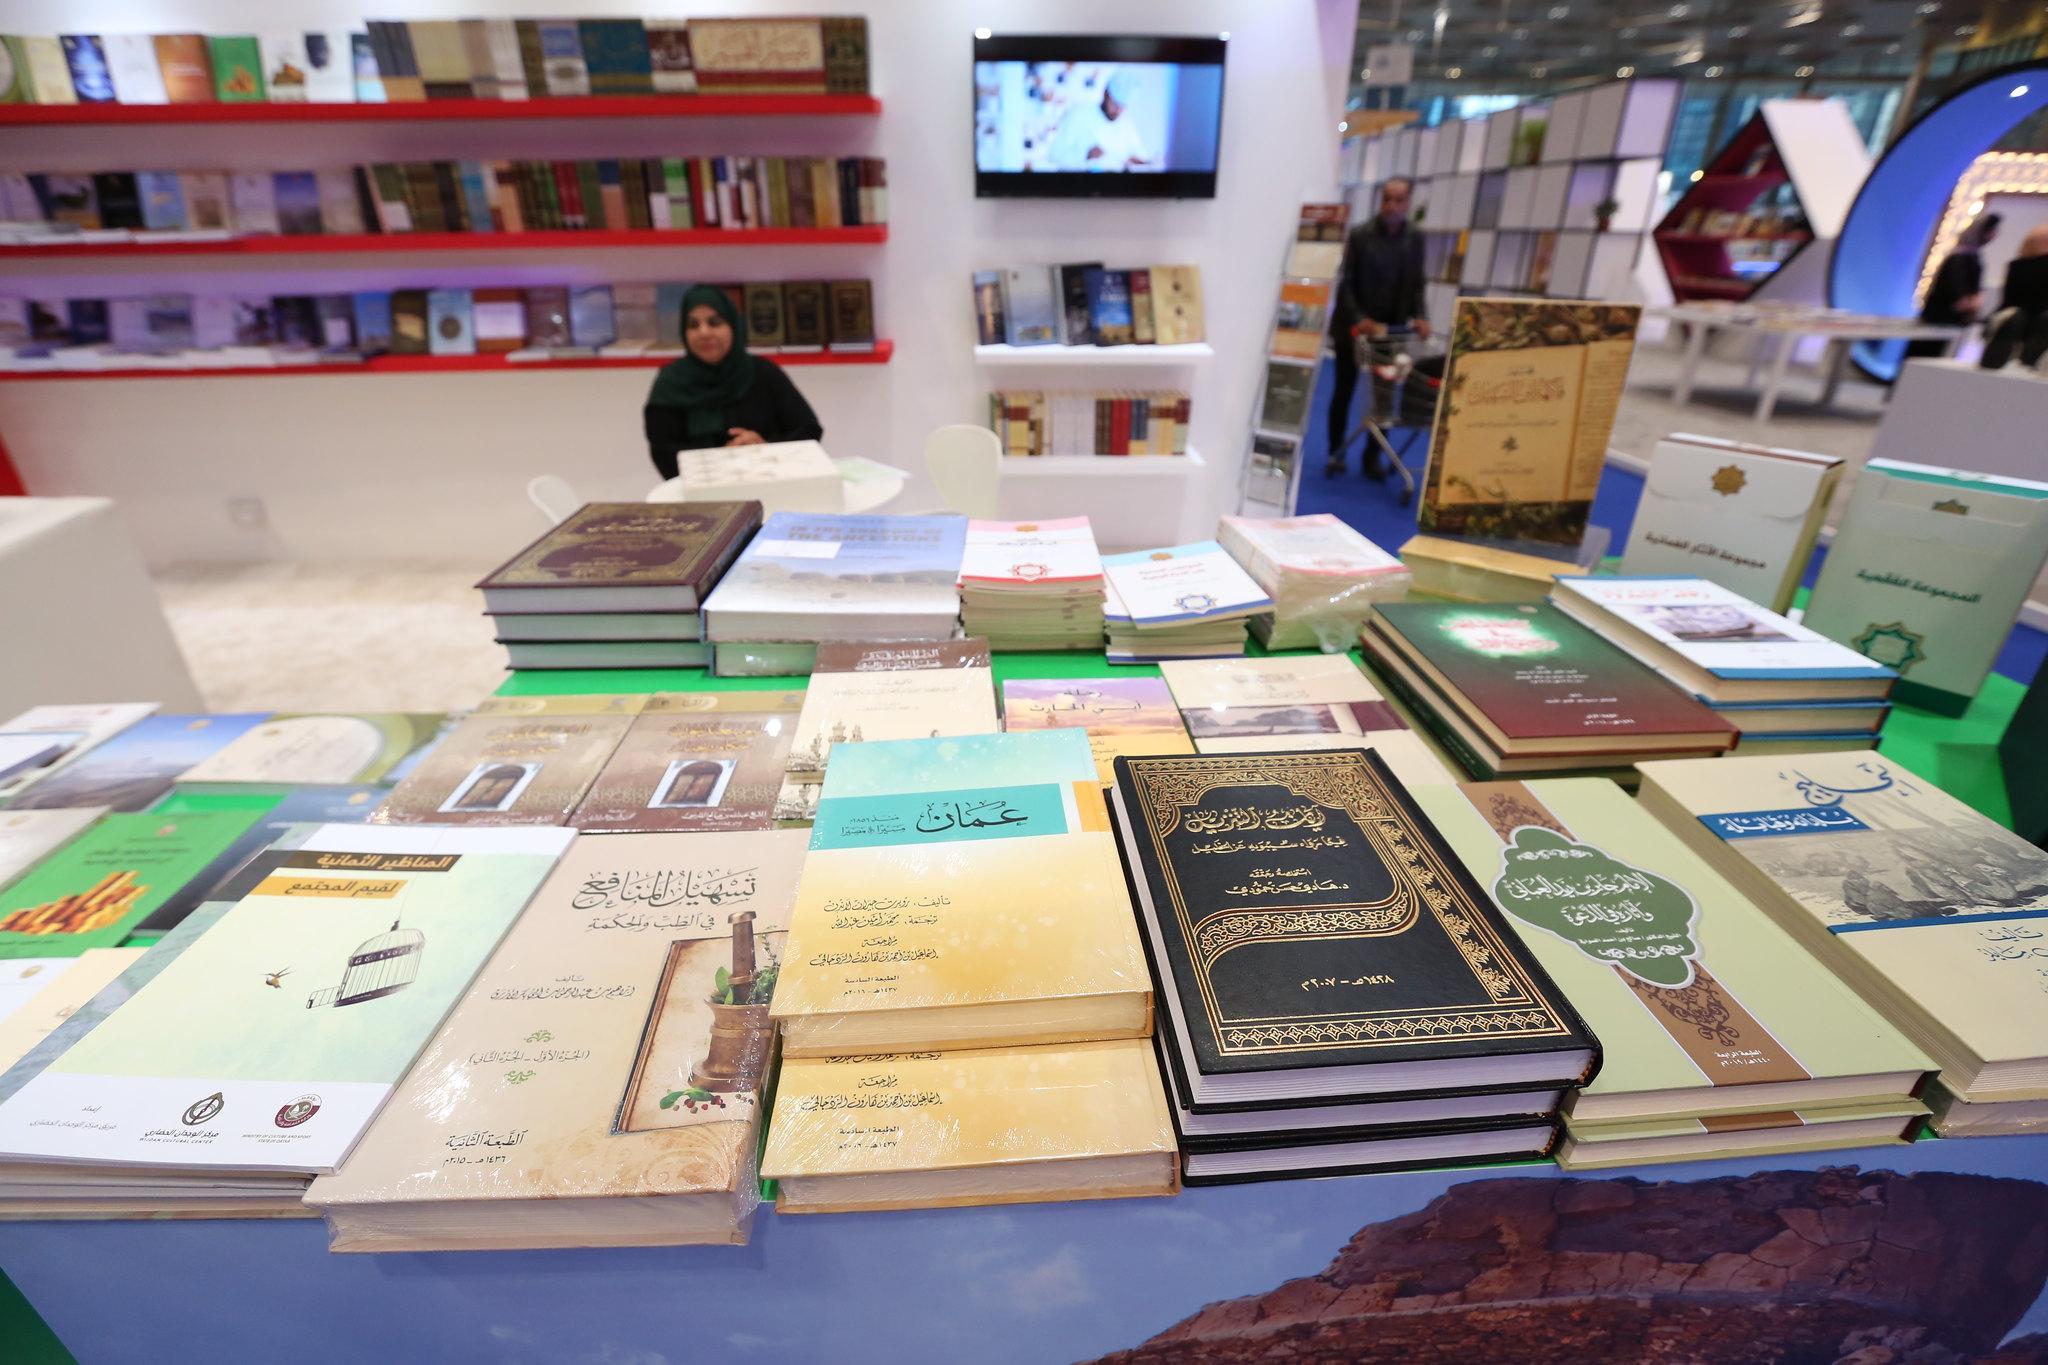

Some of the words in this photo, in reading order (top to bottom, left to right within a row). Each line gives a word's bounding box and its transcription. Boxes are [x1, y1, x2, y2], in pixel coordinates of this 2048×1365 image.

[317, 853, 382, 868] الثمانية
[377, 854, 454, 870] المناظير
[284, 880, 359, 895] المجتمع
[351, 881, 400, 897] لقيم
